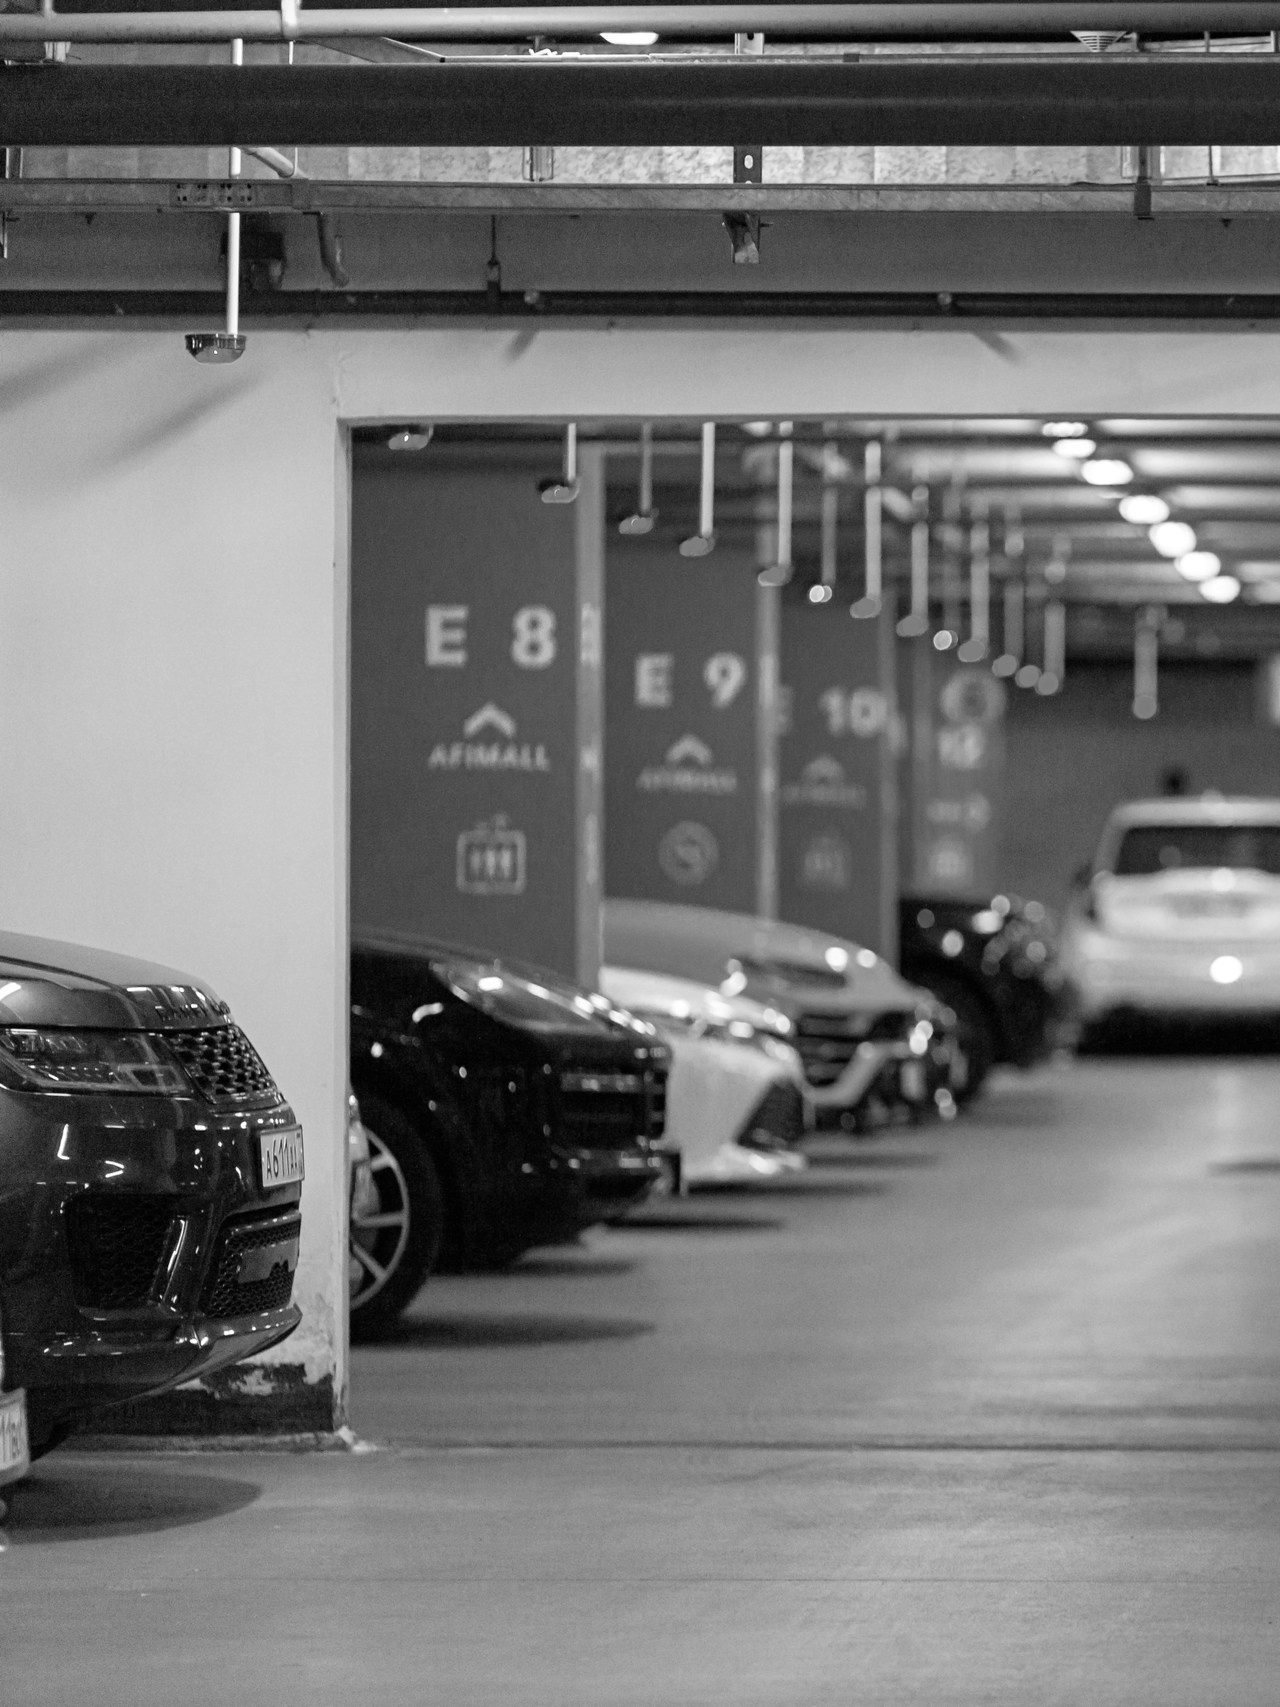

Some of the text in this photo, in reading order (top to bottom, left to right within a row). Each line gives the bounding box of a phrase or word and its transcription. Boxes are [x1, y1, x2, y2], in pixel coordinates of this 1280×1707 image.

[426, 605, 556, 669] E 8
[635, 653, 745, 708] E 9
